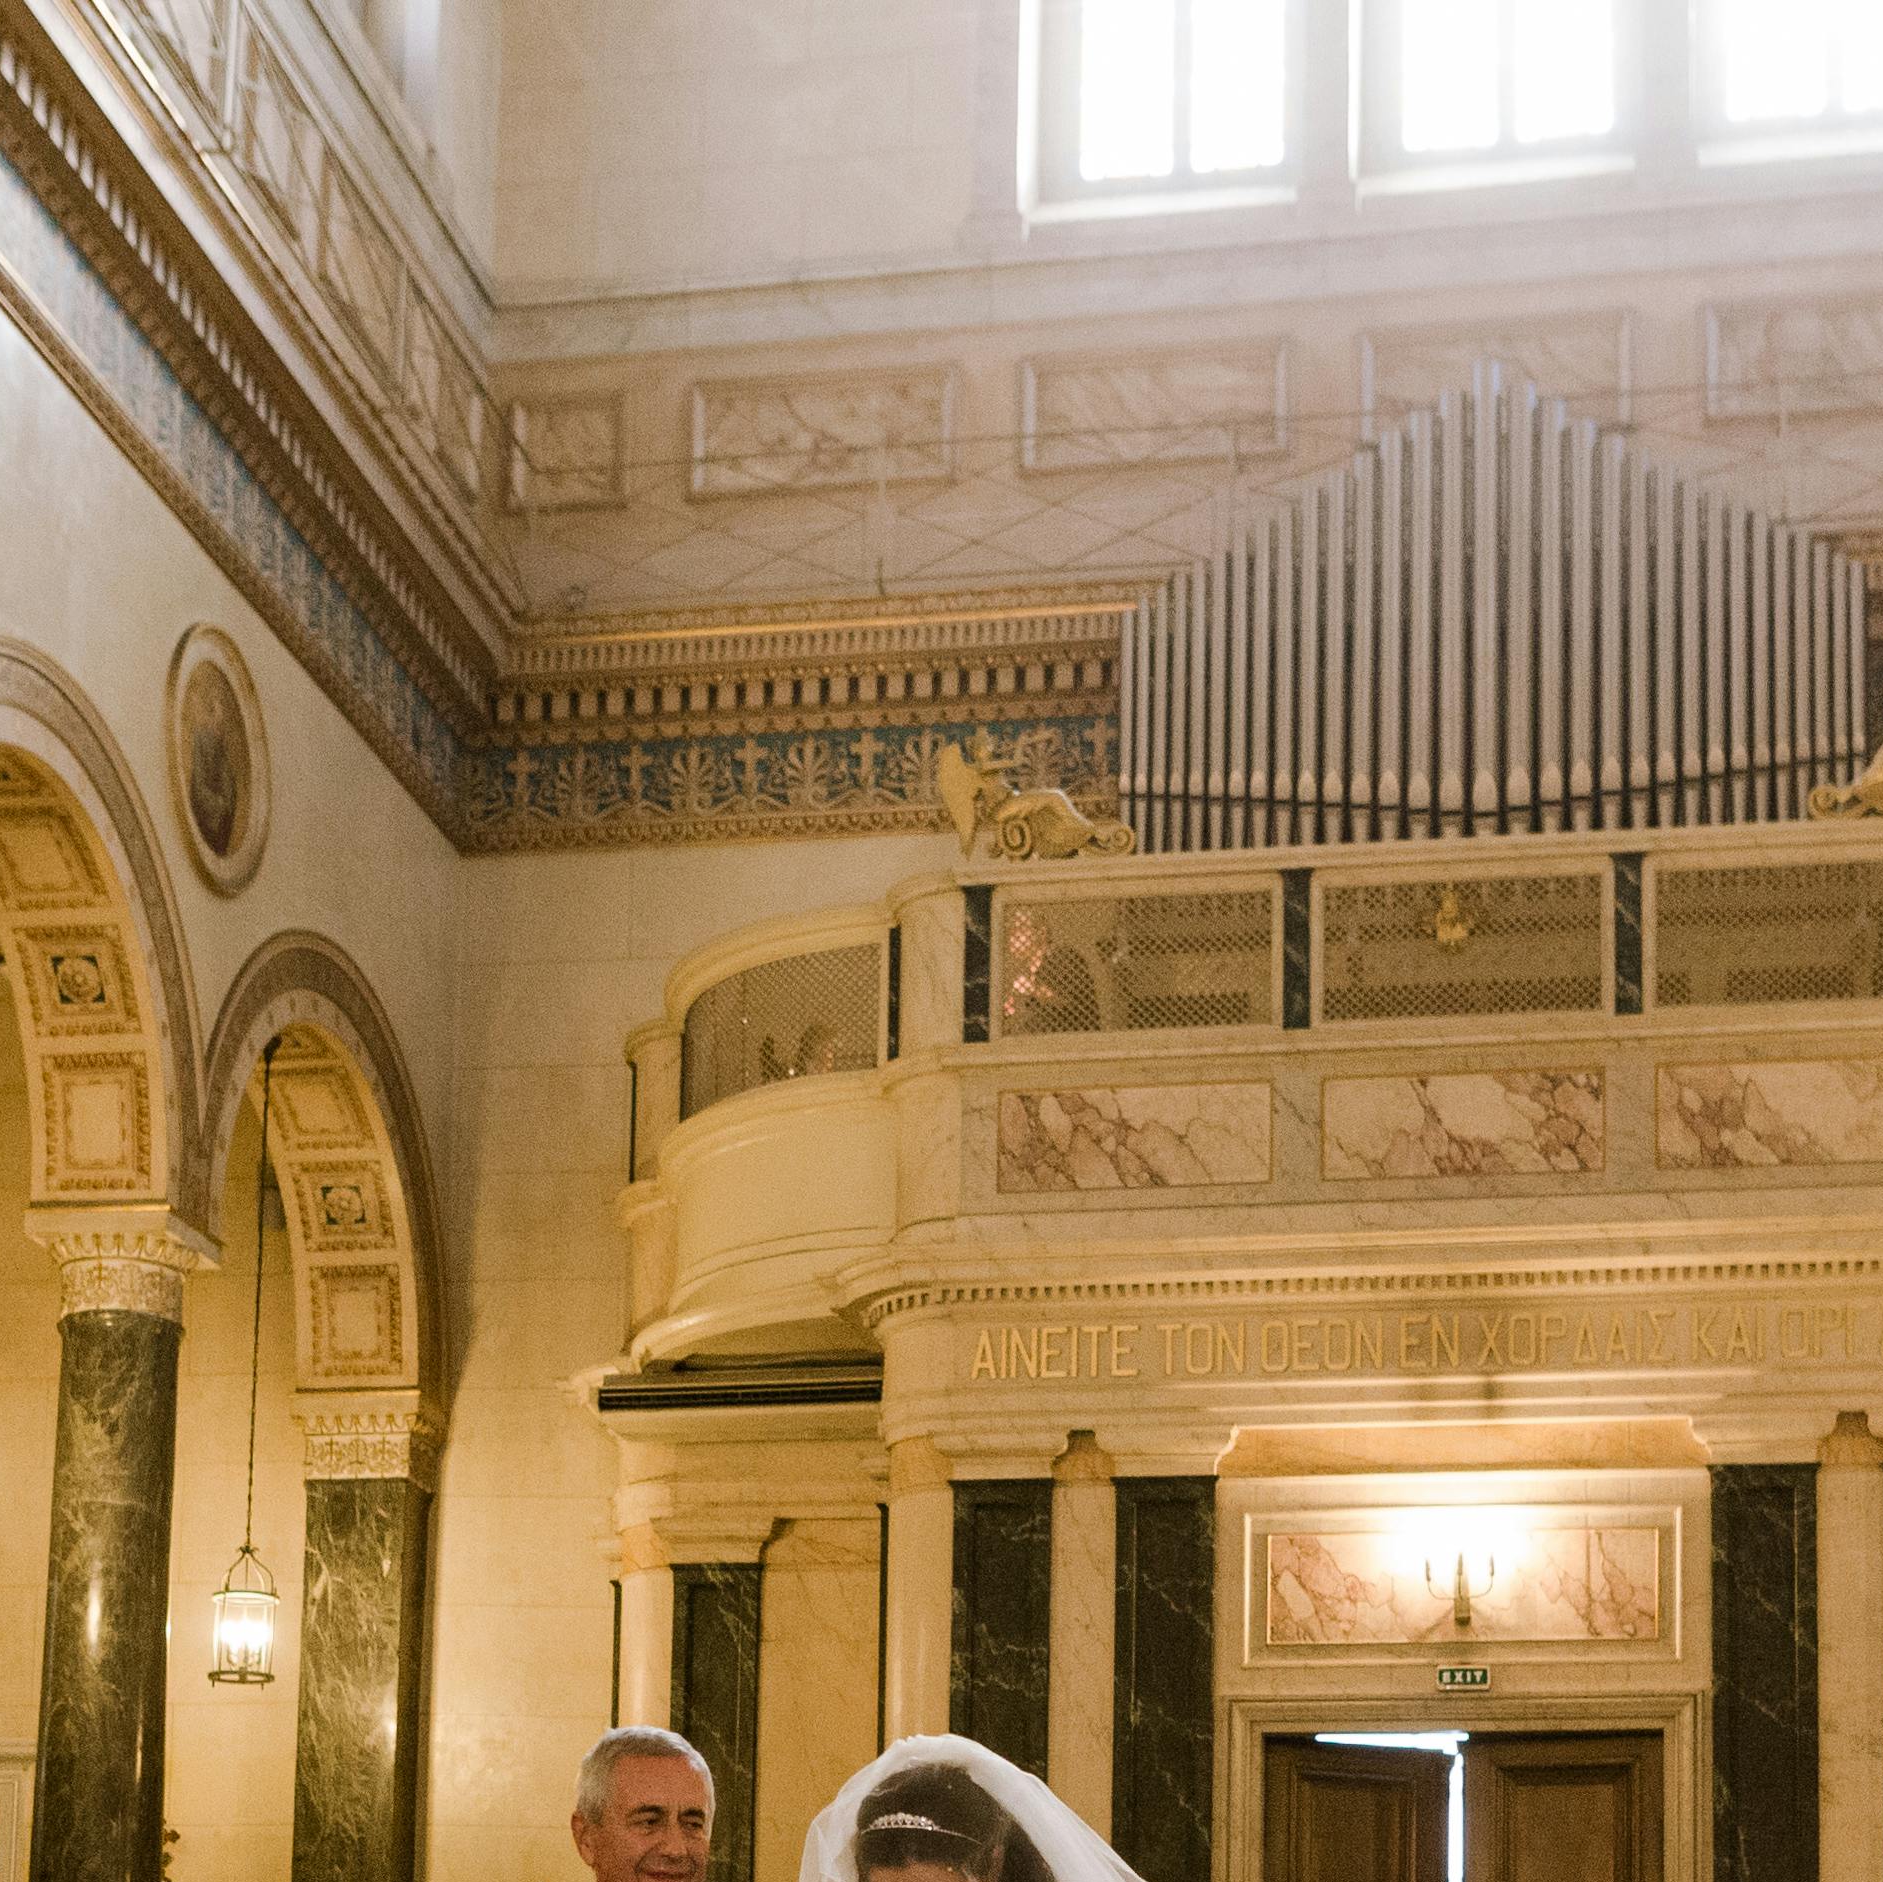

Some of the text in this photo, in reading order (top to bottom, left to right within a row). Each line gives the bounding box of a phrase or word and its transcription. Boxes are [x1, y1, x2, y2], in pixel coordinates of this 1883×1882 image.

[971, 1323, 1141, 1380] ΑΙΝΕΙΤΕ
[1156, 1320, 1246, 1376] ΤΟΝ
[1399, 1313, 1460, 1369] ΕΝ
[1478, 1309, 1677, 1367] ΧΟΡΔΑΙΣ
[1691, 1305, 1767, 1363] ΚΑΙ
[1442, 1670, 1484, 1683] EXIT
